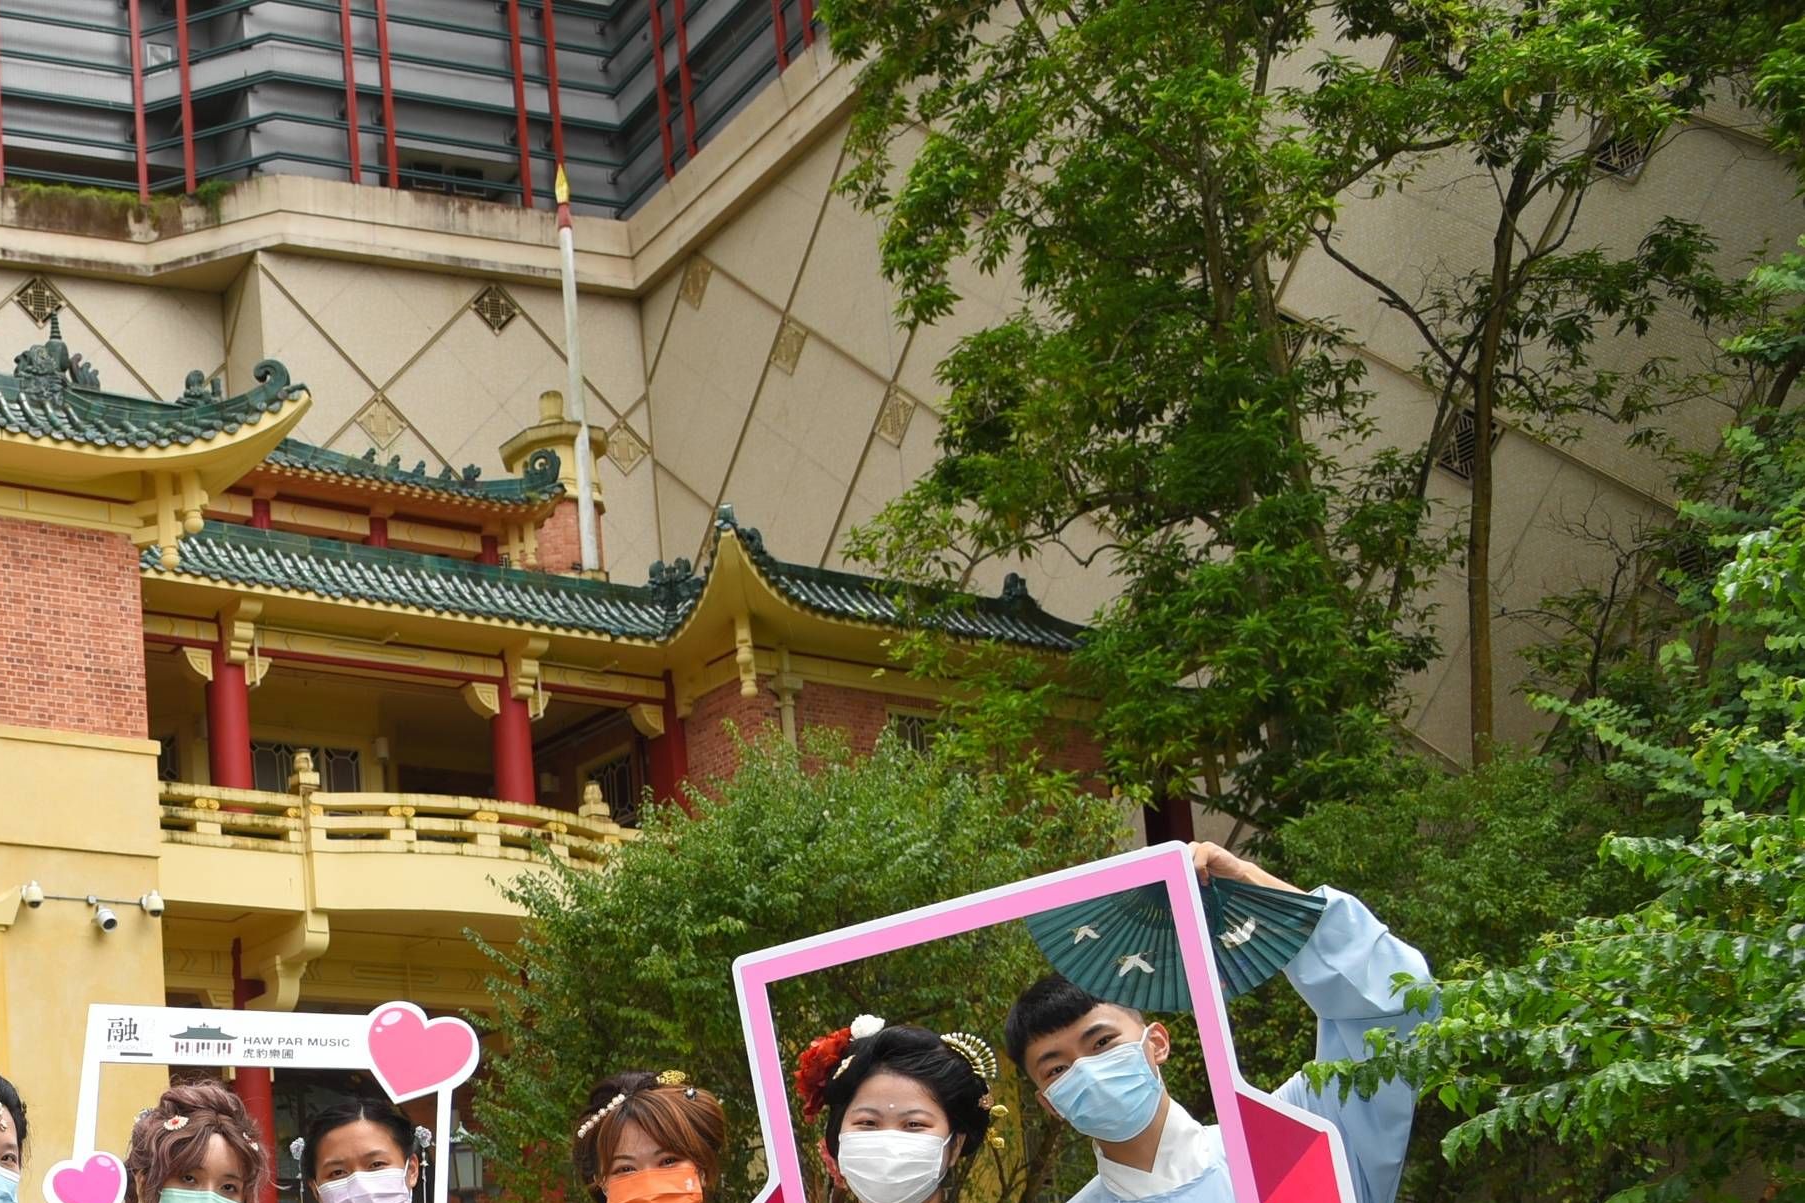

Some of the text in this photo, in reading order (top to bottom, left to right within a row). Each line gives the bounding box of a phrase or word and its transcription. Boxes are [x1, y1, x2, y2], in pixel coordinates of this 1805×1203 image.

[107, 1017, 139, 1043] 融
[243, 1037, 350, 1047] HAW PAR MUSIC
